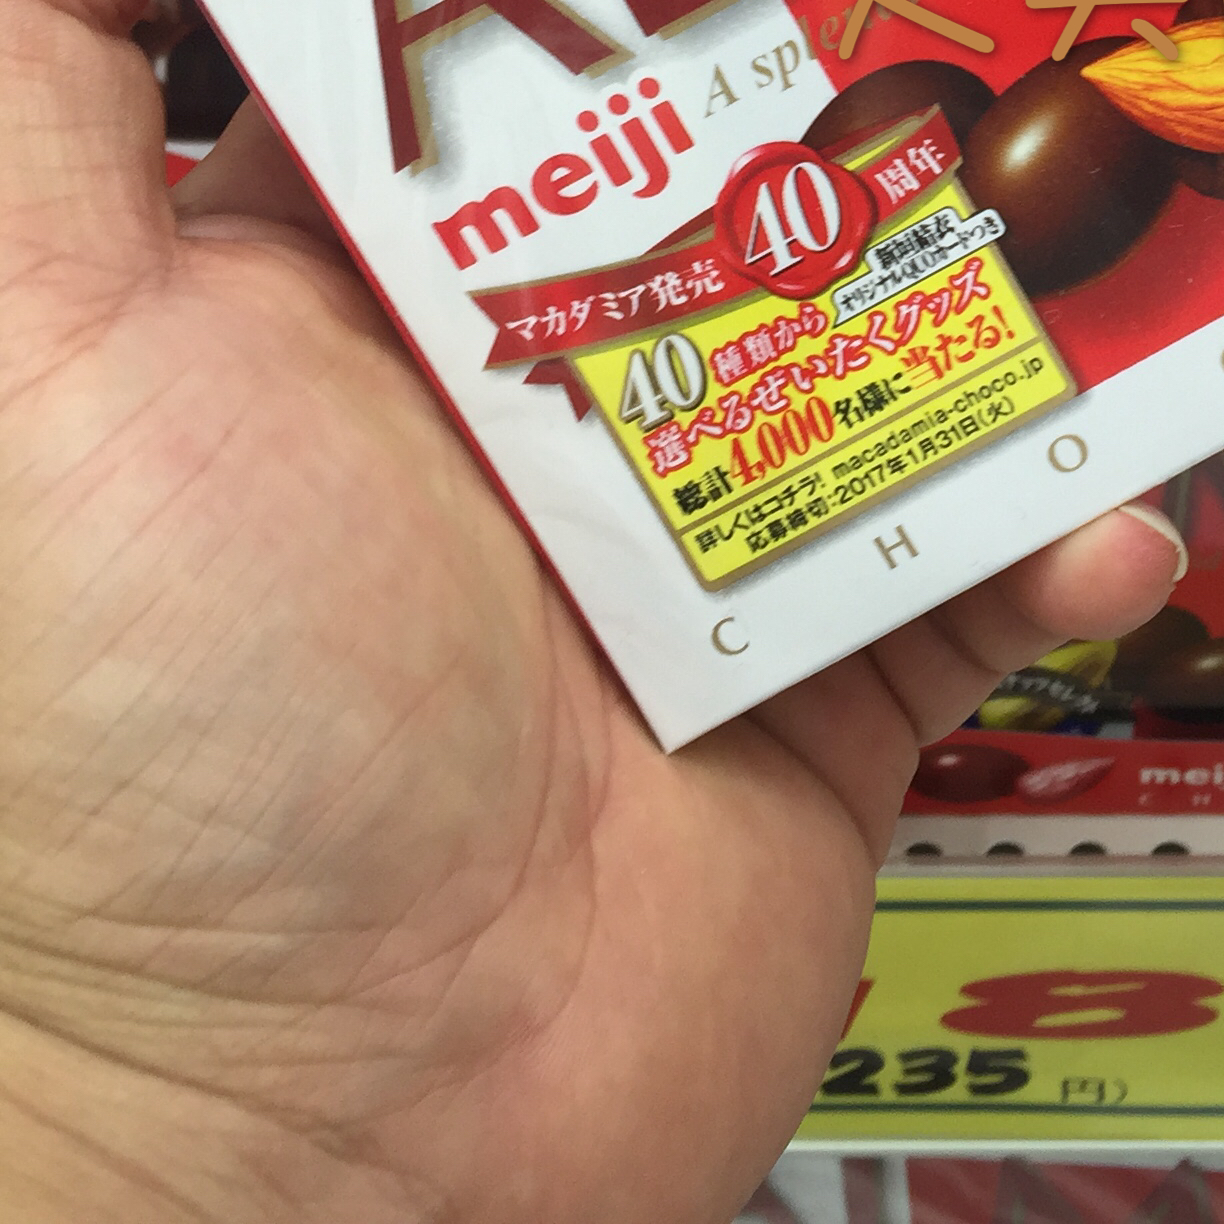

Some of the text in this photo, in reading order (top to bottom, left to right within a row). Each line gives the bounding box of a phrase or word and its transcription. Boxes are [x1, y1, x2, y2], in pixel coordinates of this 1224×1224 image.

[430, 77, 697, 271] meiji
[703, 61, 741, 118] A
[504, 137, 947, 342] マカダミア発売 40 周年
[618, 303, 829, 433] 40 種類から
[644, 258, 991, 477] 選べるぜいたくグッズ
[694, 355, 1046, 554] 詳しくはコチラ! macadamia-choco.jp
